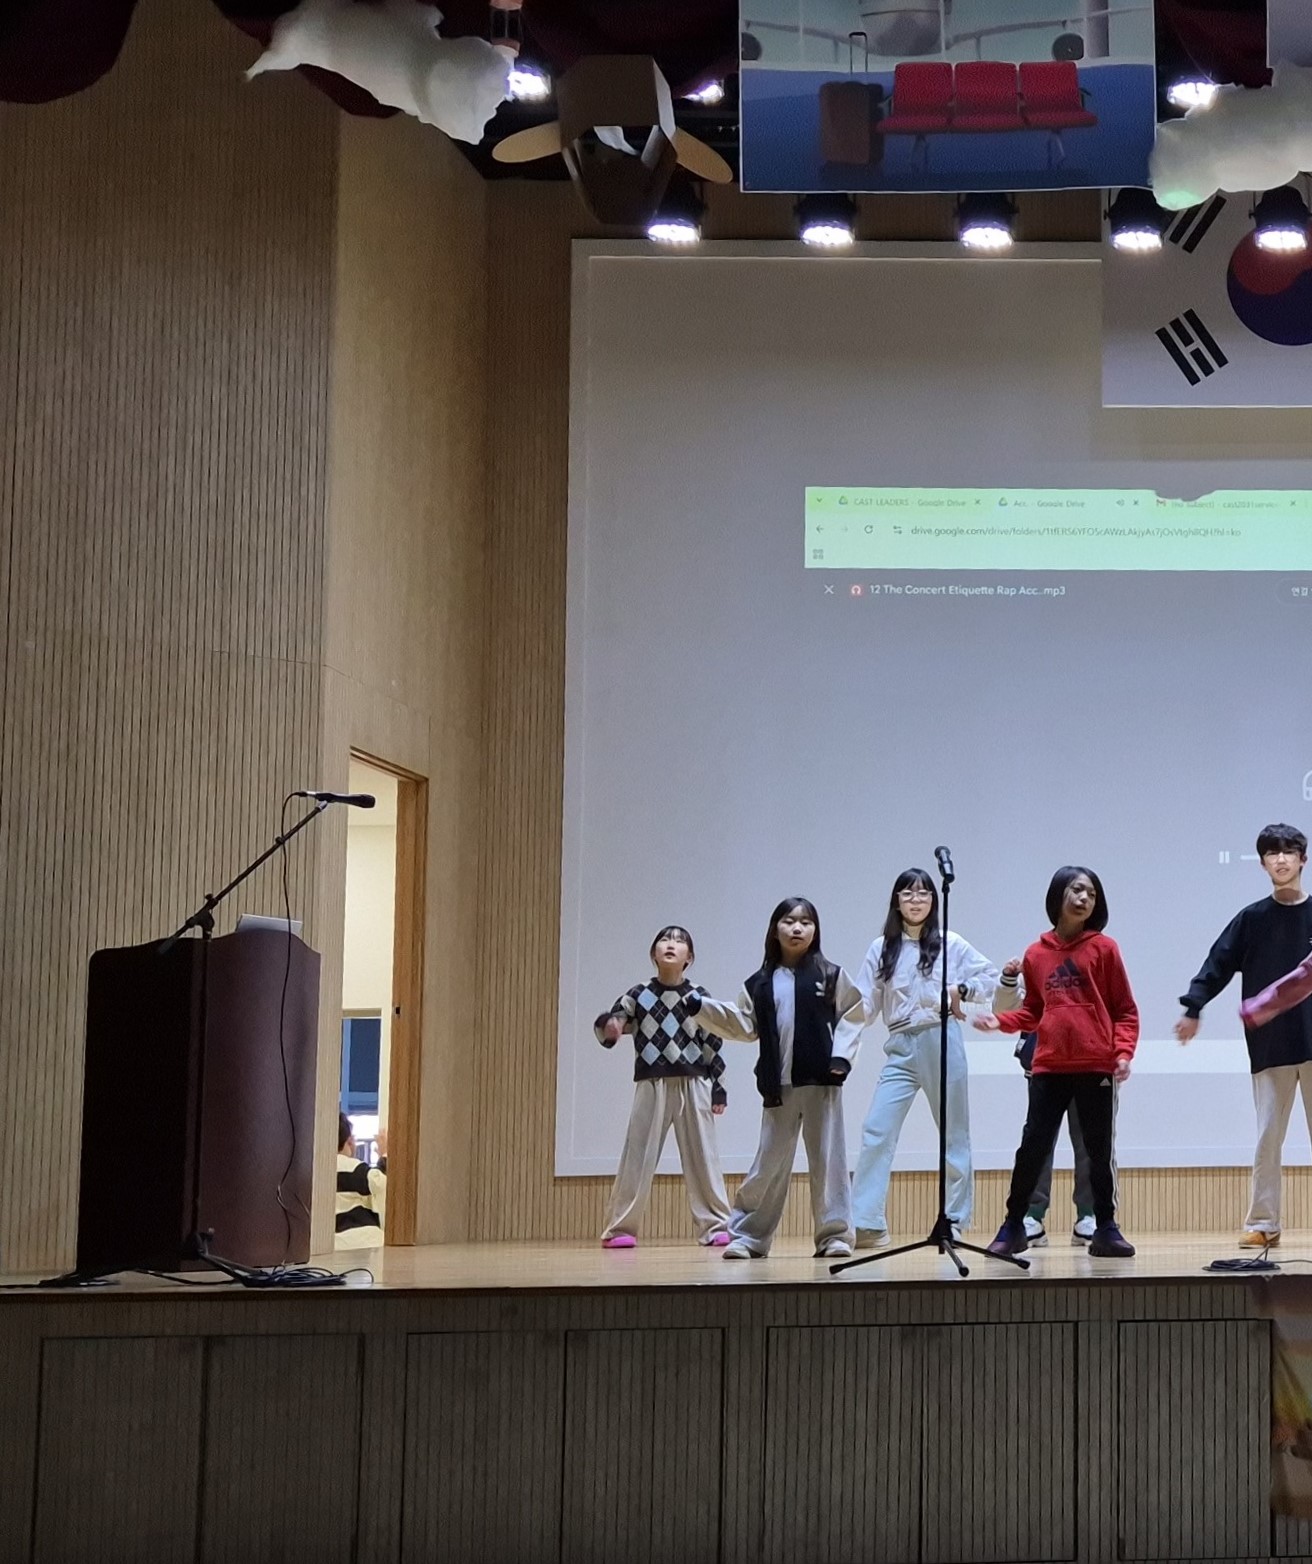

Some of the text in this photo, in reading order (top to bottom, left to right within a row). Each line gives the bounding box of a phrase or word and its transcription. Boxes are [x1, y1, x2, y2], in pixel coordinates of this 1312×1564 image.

[917, 499, 946, 508] Google
[948, 499, 966, 507] Drive
[870, 584, 881, 595] 12
[883, 584, 903, 595] The
[904, 584, 947, 596] Concert
[948, 584, 995, 598] Etiquette
[996, 585, 1017, 598] Rap
[1045, 976, 1087, 991] adida
